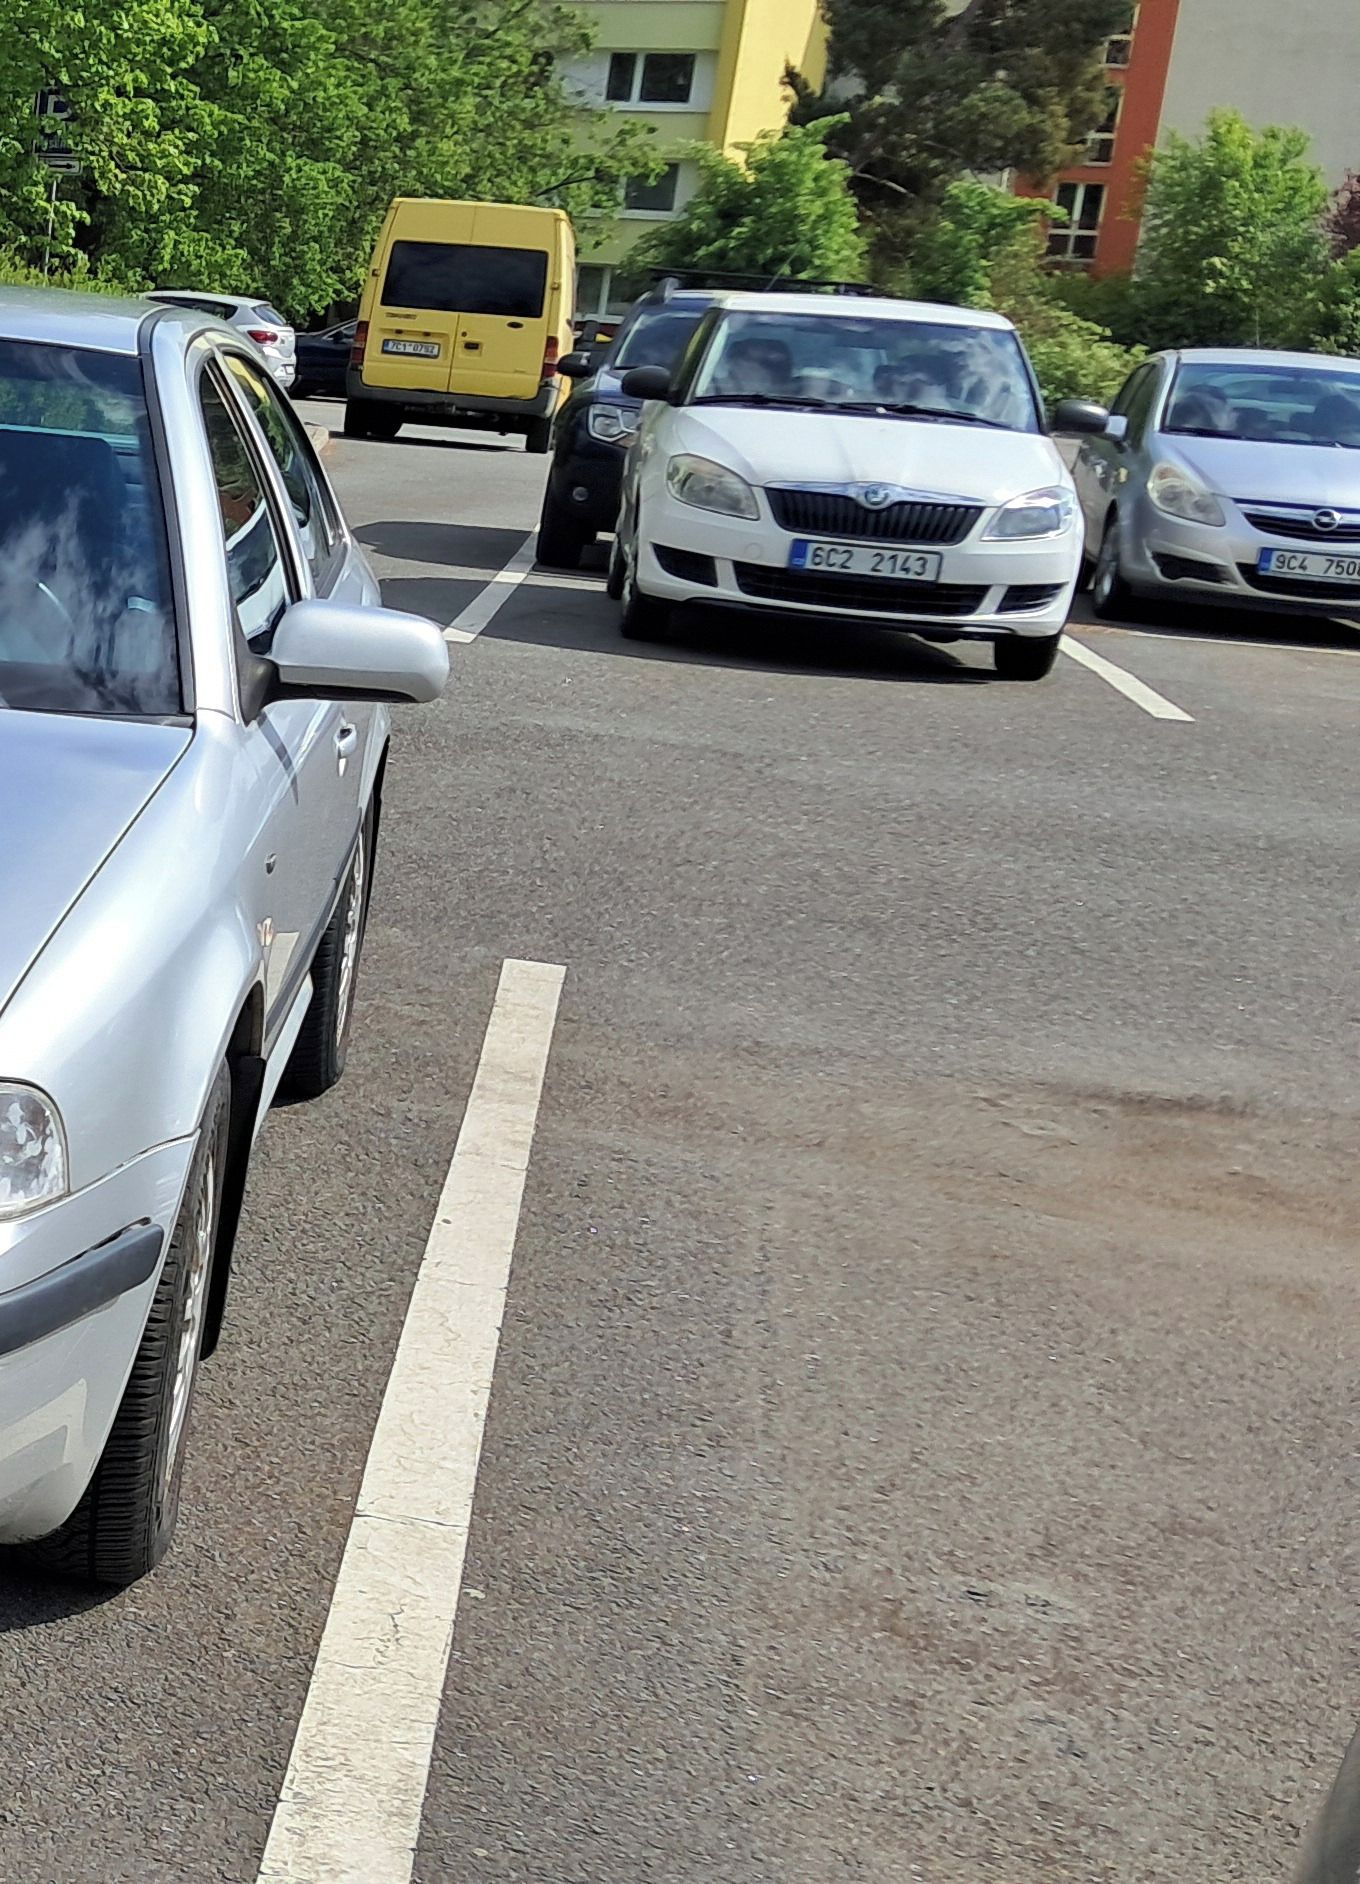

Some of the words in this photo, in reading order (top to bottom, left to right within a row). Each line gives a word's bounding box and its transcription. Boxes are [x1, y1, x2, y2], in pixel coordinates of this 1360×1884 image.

[811, 547, 854, 570] 6C2
[871, 552, 928, 576] 2143
[1275, 553, 1308, 572] 9C4
